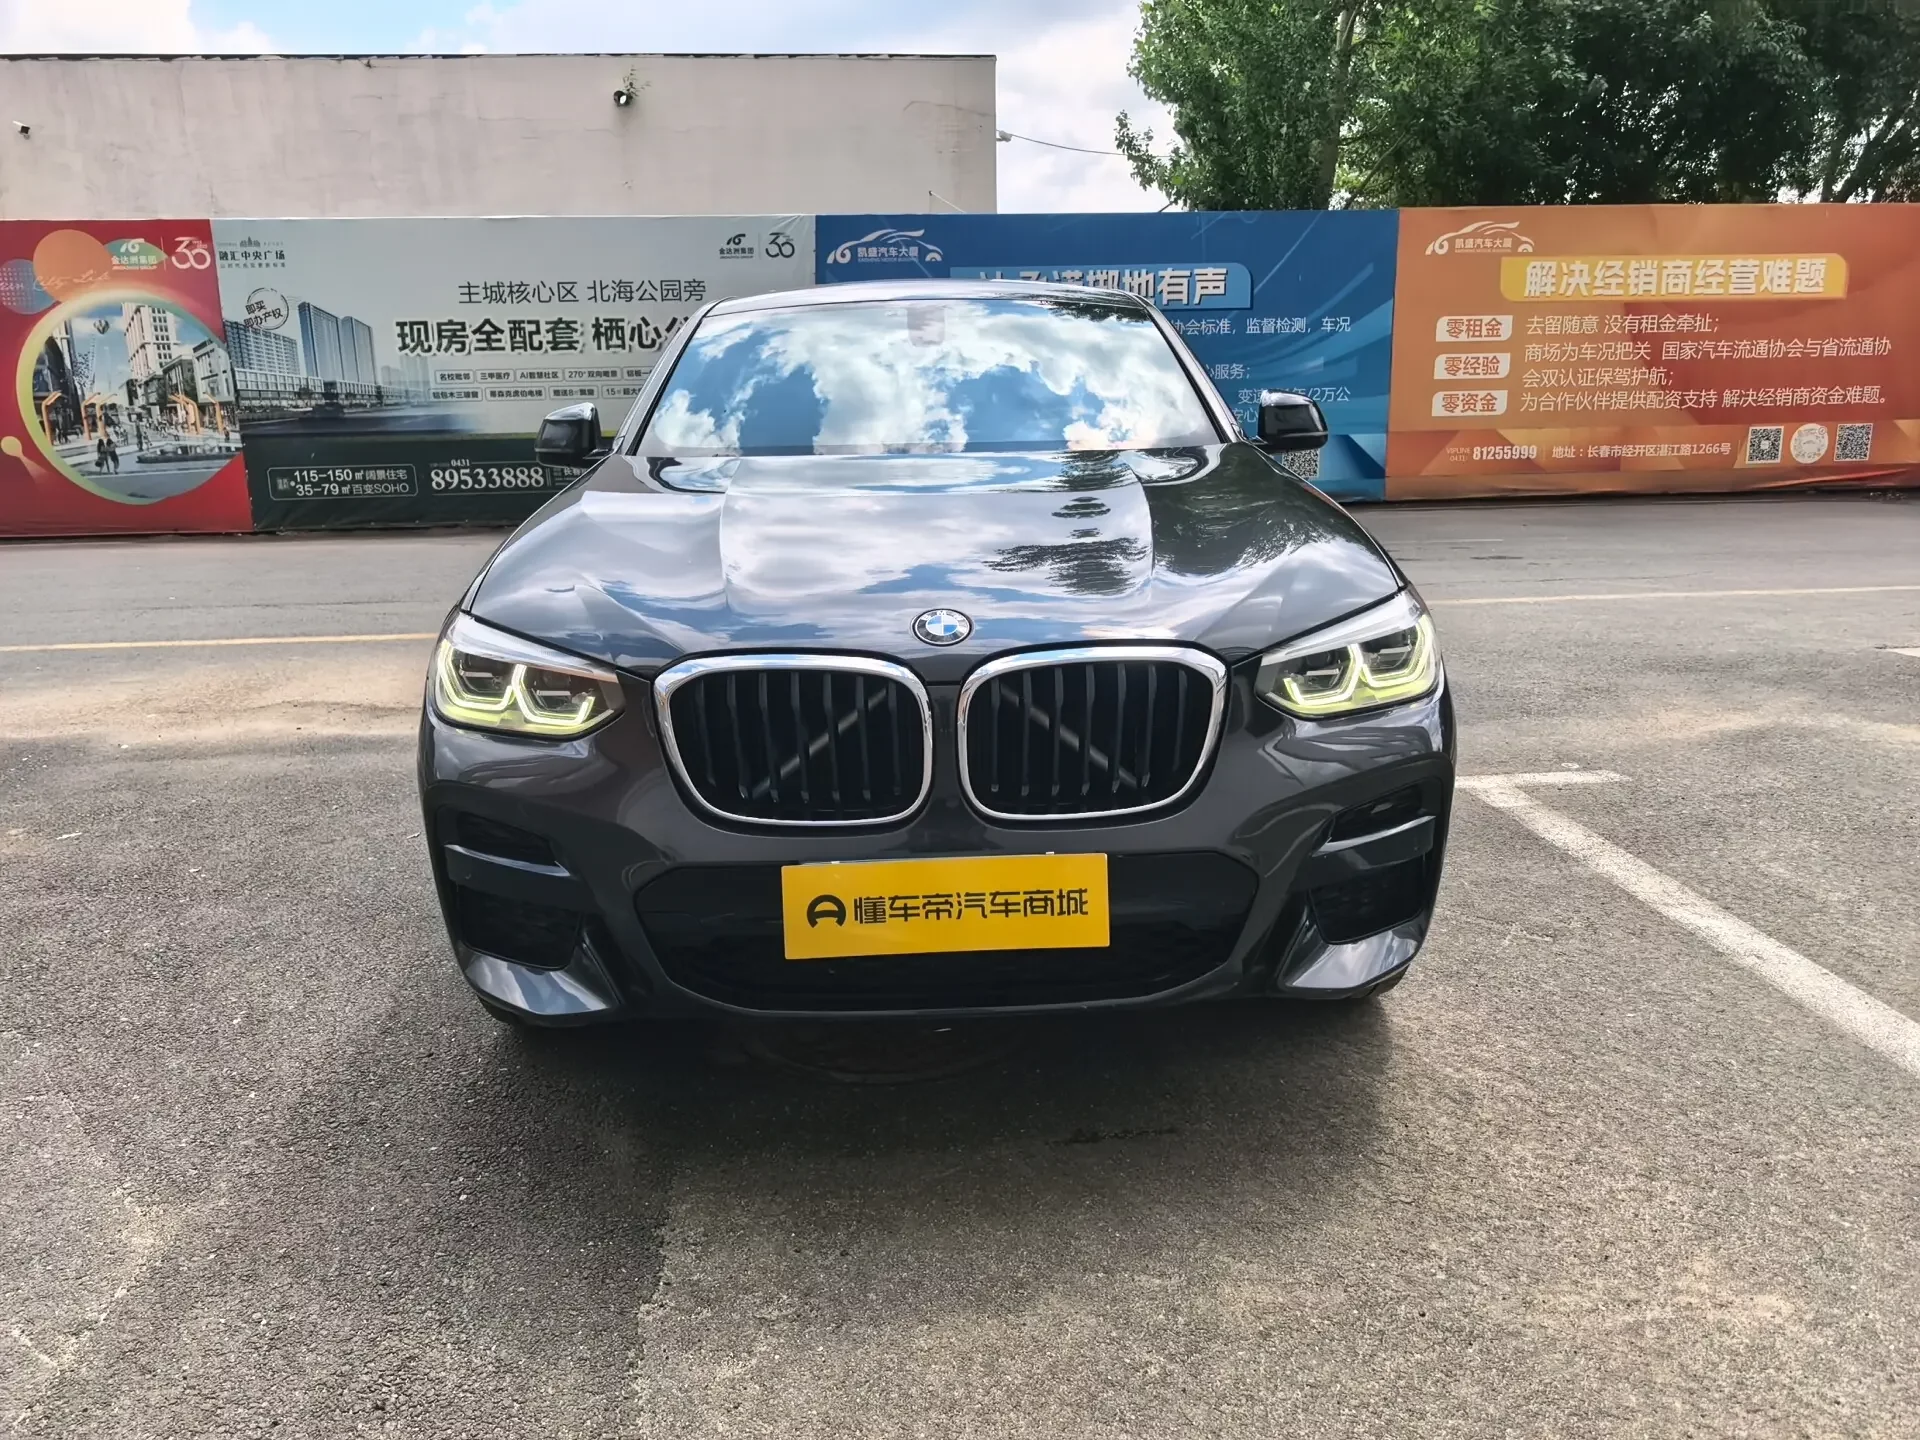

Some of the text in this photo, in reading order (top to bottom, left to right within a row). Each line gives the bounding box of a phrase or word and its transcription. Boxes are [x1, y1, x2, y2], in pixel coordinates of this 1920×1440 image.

[857, 246, 919, 258] 凯盛汽车大厦
[1524, 257, 1827, 298] 解决经销商经营难题
[458, 278, 707, 304] 主城核心区 北海公园旁
[395, 317, 580, 352] 现房全配套
[1446, 317, 1503, 339] 零租金
[1525, 315, 1600, 335] 去留随意
[1525, 336, 1892, 362] 商场为车况把关 国家汽车流通协会与省流通协
[1444, 355, 1501, 377] 零经验
[1442, 392, 1498, 413] 零资金
[1520, 389, 1718, 412] 为合作伙伴提供配资支持
[451, 459, 470, 468] 0431
[1472, 445, 1538, 461] 81255999
[430, 467, 544, 490] 89533888
[853, 888, 1089, 925] 懂车帝汽车商城
